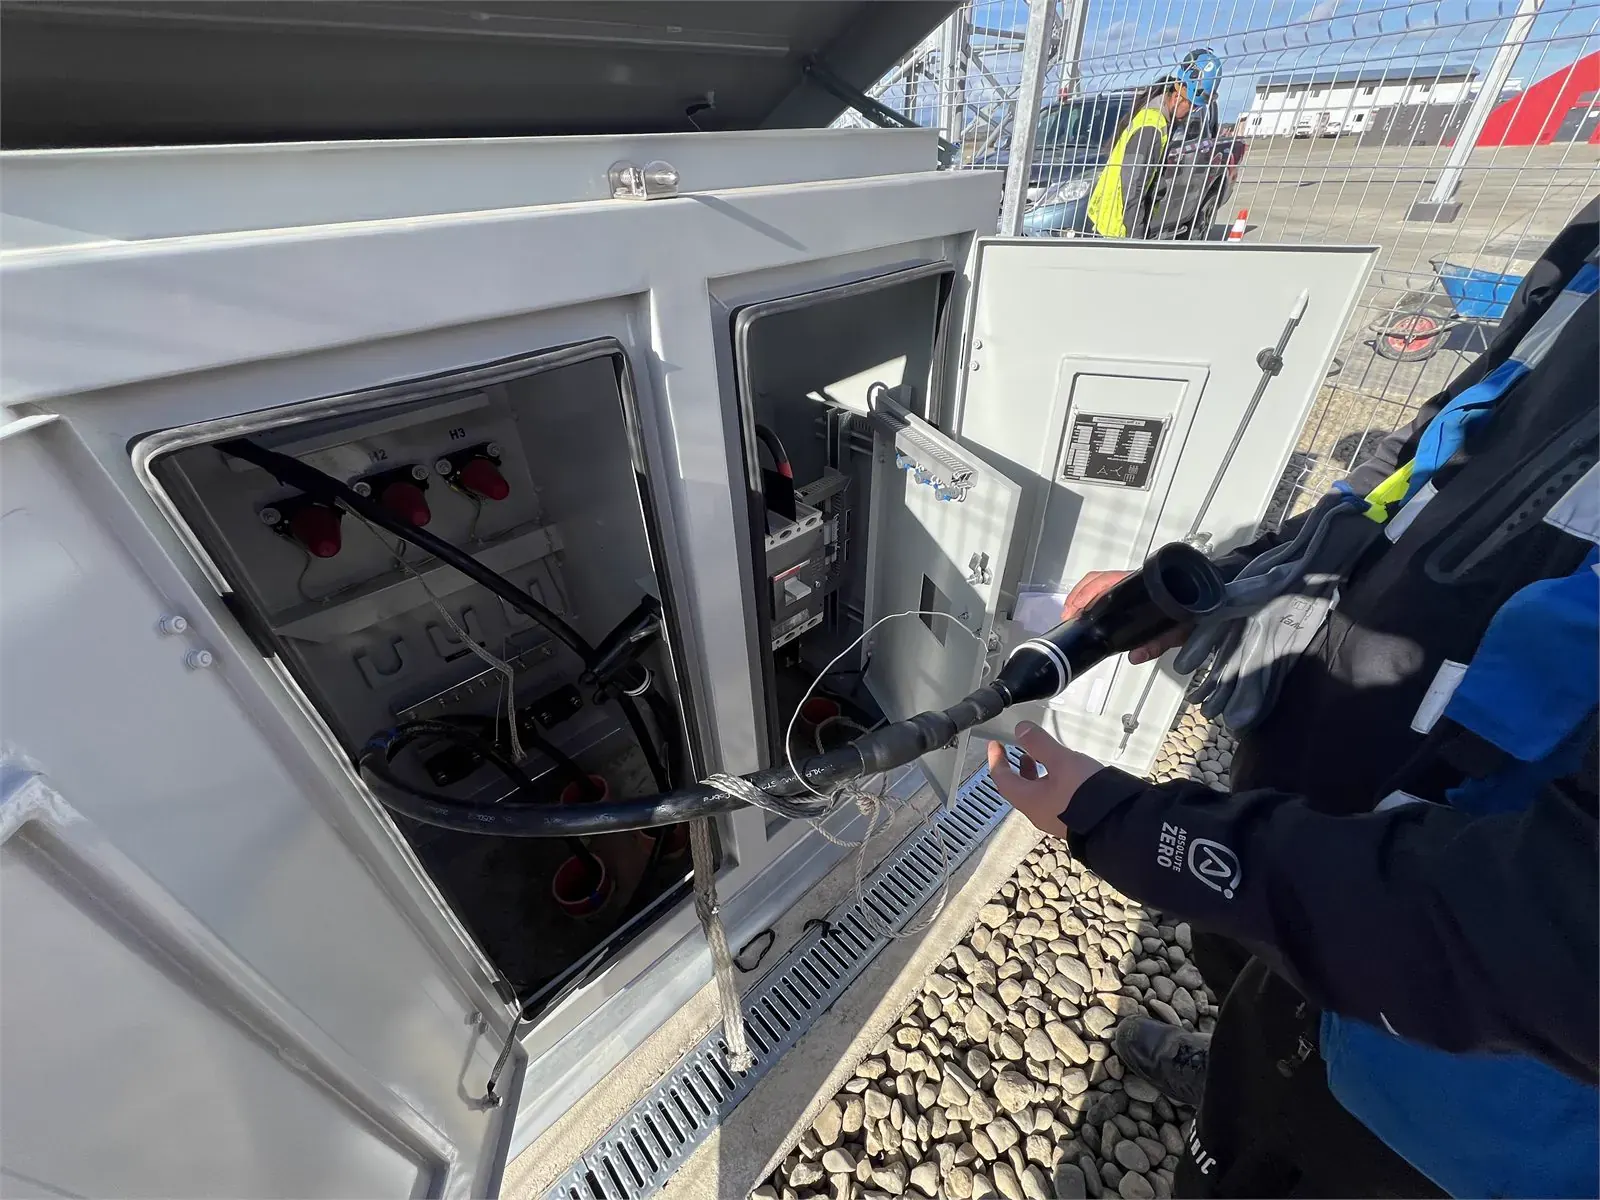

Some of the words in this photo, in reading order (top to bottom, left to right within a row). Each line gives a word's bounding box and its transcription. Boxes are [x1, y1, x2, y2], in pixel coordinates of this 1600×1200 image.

[449, 427, 466, 441] H3
[1156, 821, 1179, 868] ZERO
[1172, 827, 1188, 873] ABSOLUTE
